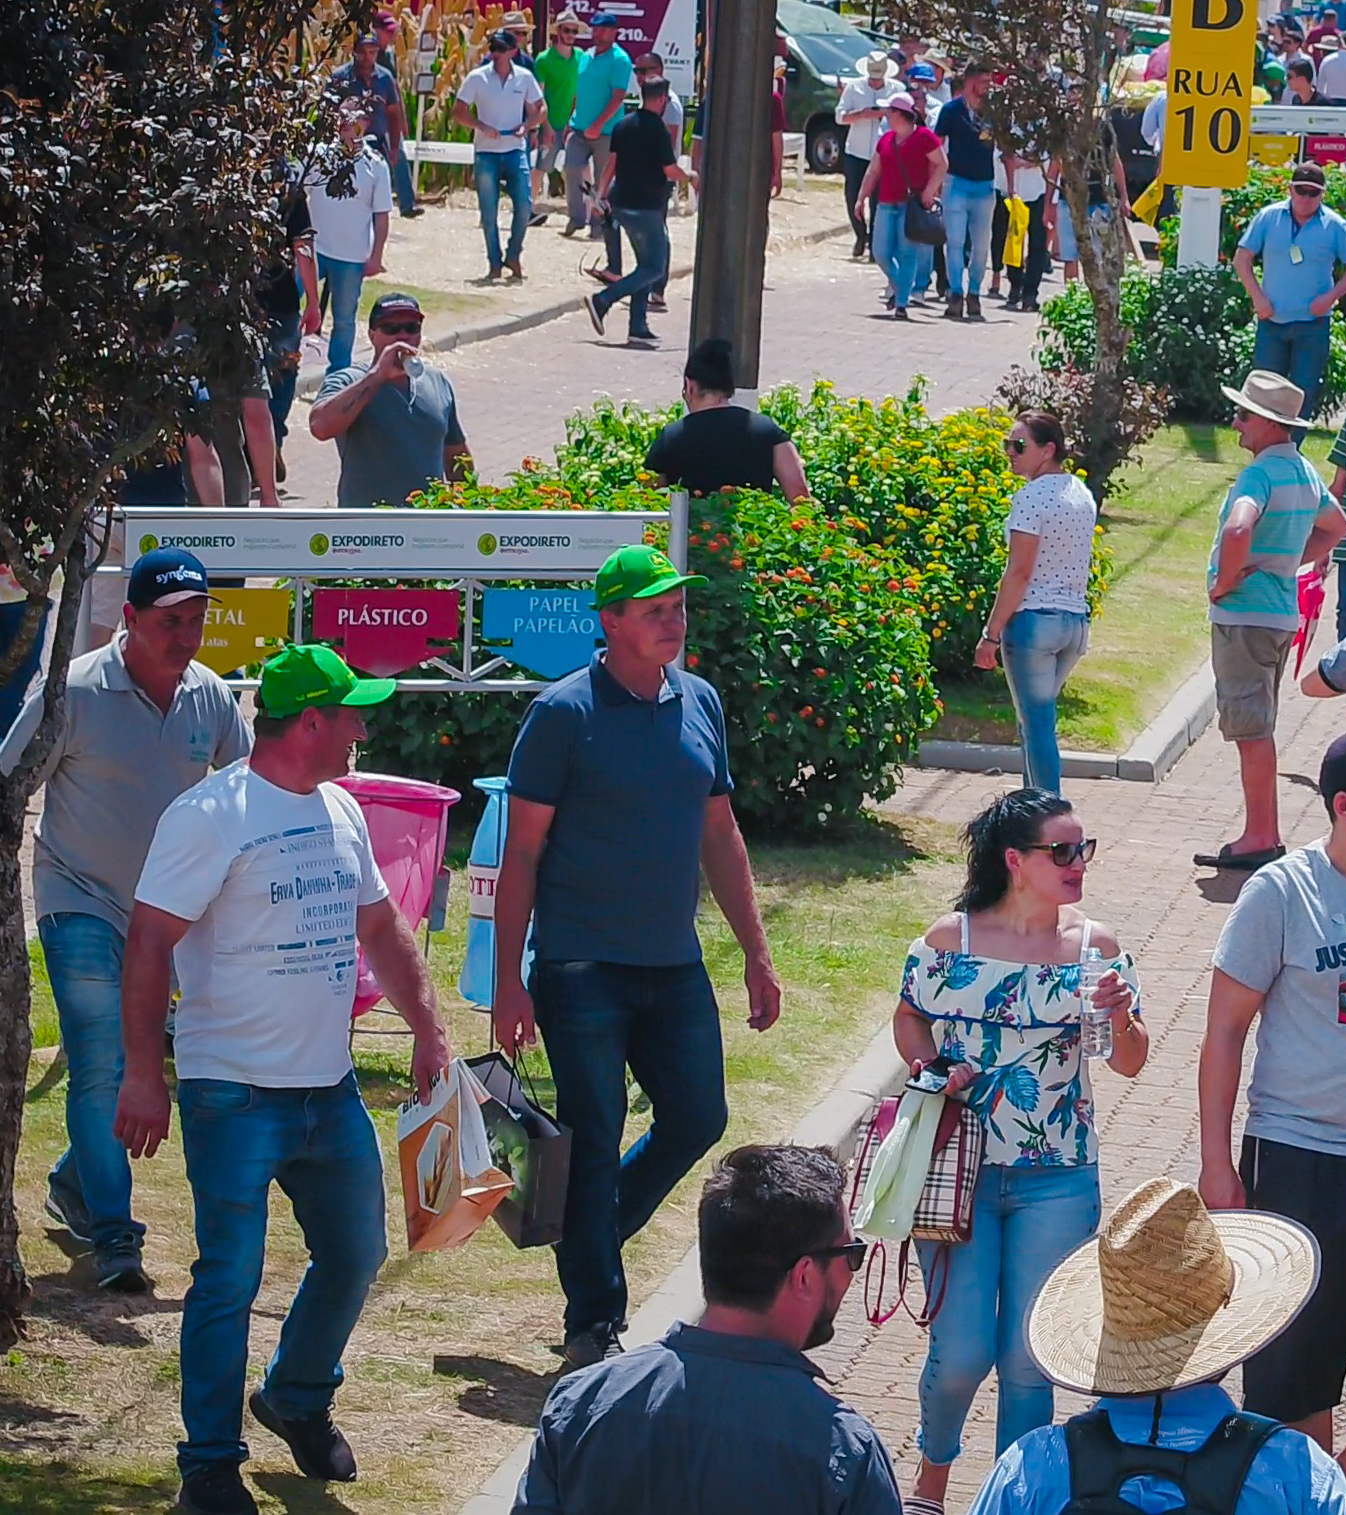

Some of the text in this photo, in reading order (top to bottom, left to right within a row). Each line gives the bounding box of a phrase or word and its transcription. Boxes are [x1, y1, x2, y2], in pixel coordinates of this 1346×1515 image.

[1173, 69, 1243, 97] RUA
[1174, 105, 1242, 154] 10
[161, 535, 236, 548] EXPODIRETO
[332, 535, 405, 548] EXPODIRETO
[500, 535, 571, 548] EXPODIRETO
[529, 596, 581, 614] PAPEL
[203, 608, 247, 626] ETAL
[337, 604, 428, 626] PLÁSTICO
[514, 612, 596, 635] PAPELÃO
